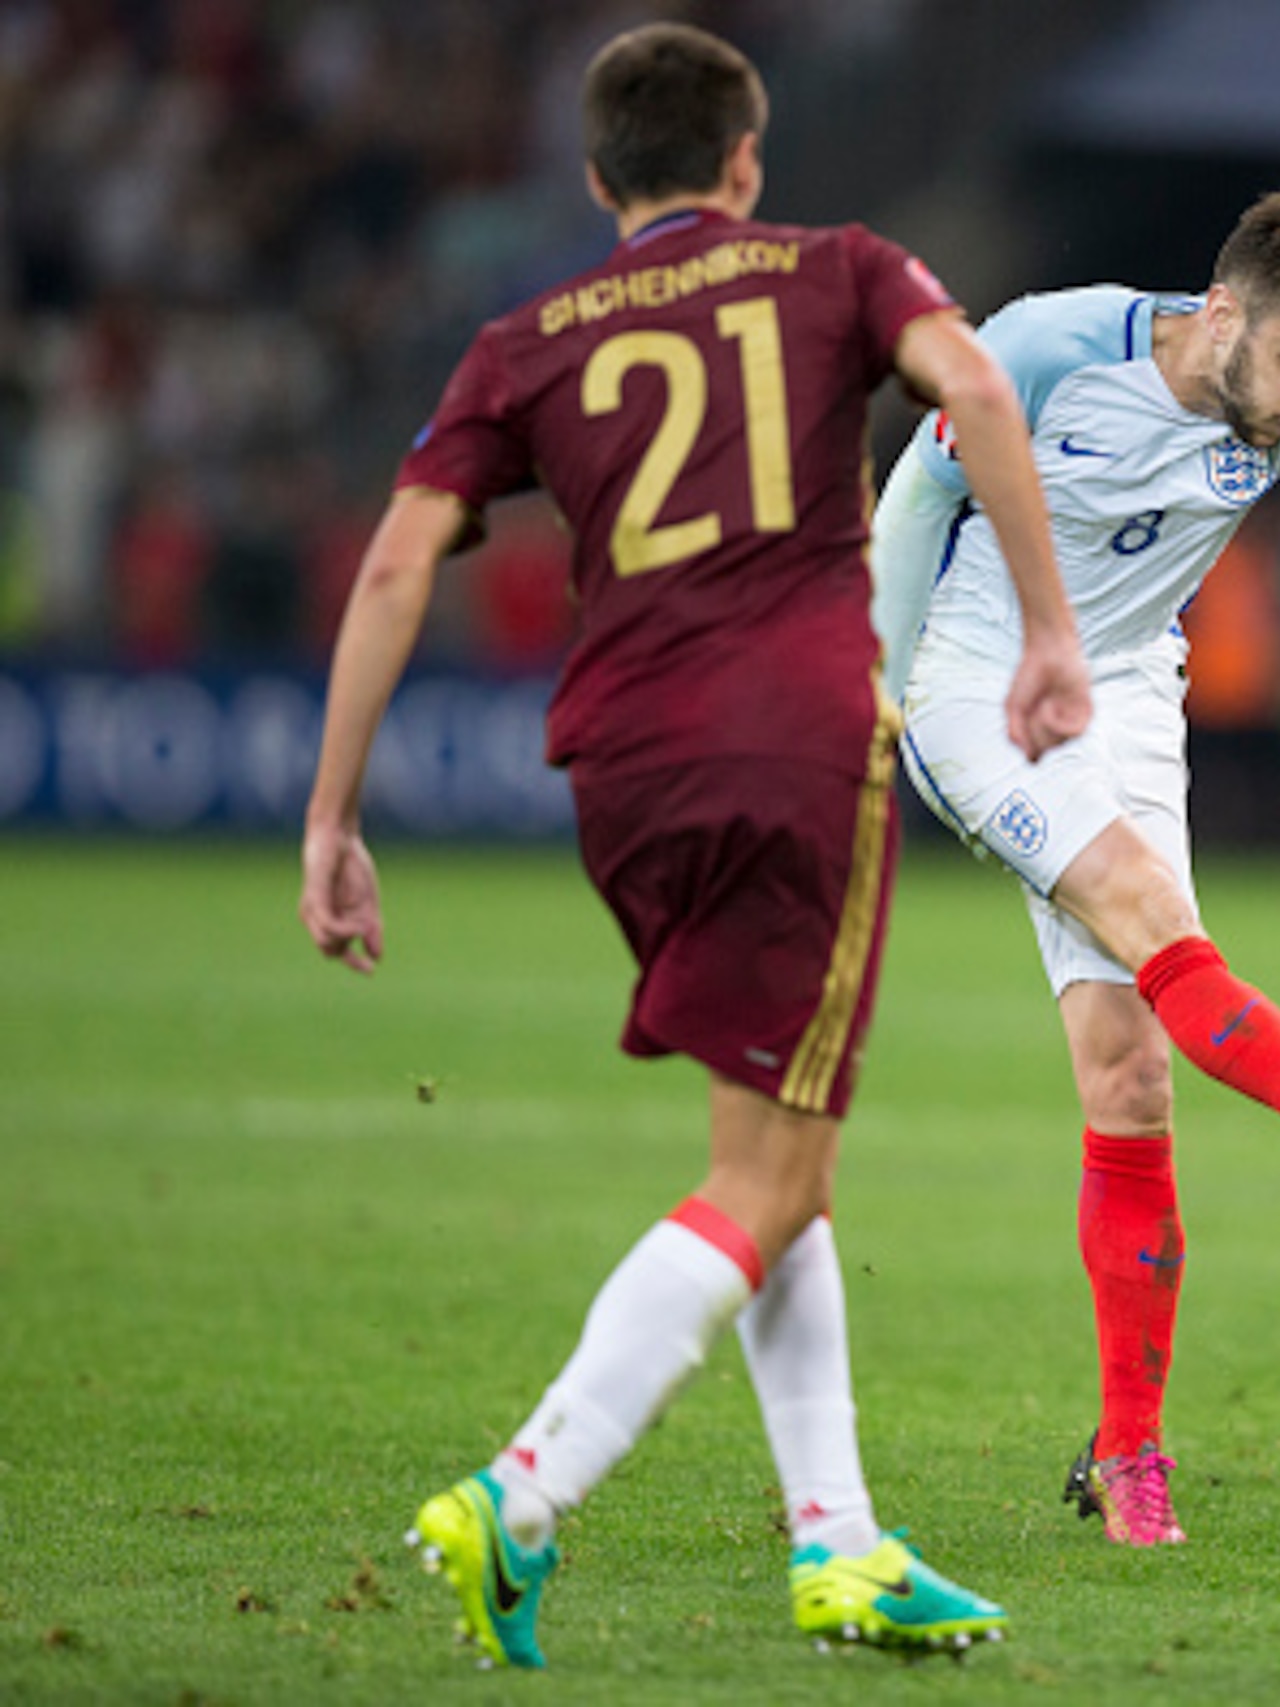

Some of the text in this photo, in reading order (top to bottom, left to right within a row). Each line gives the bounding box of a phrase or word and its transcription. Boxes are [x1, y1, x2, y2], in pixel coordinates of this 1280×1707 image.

[539, 239, 800, 337] SHCHENNIKOV
[580, 296, 796, 578] 21
[1111, 509, 1166, 555] 8
